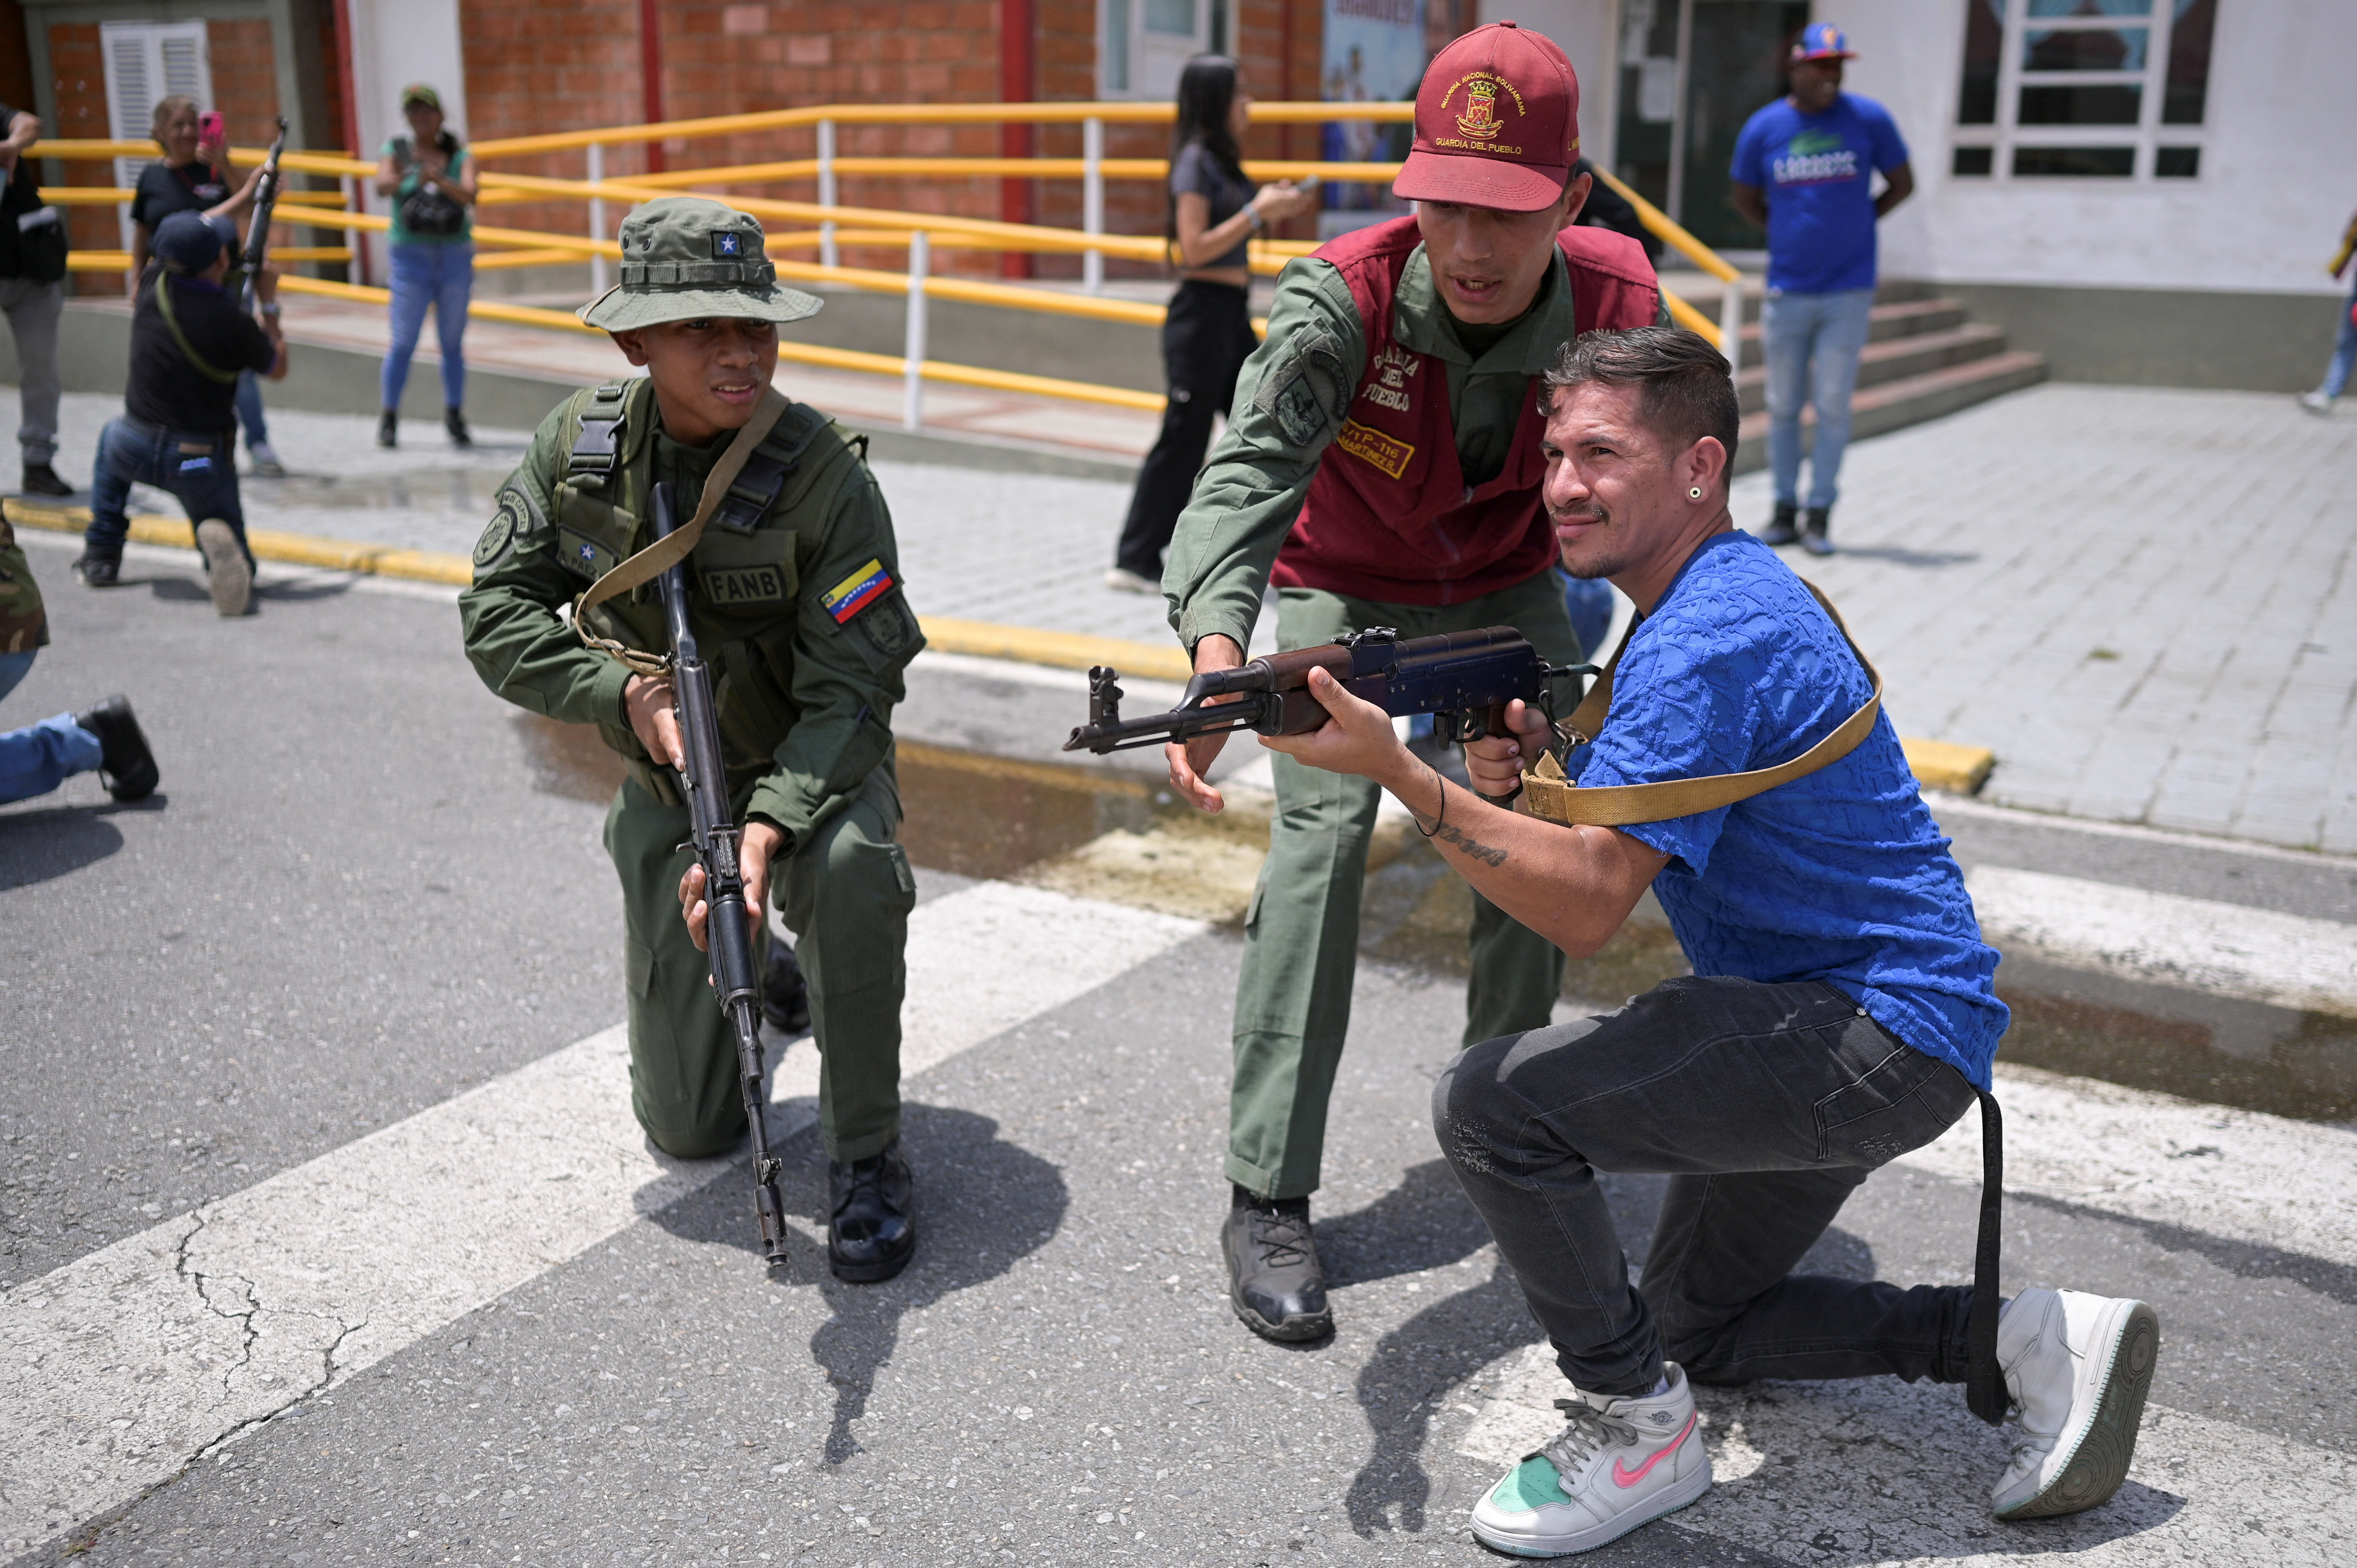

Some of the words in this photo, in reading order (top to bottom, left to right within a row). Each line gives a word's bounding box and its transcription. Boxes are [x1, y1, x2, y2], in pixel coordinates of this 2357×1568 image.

[1441, 81, 1461, 109] GUARDIA
[1461, 71, 1494, 84] NACIONAL
[1495, 76, 1526, 117] BOLIVARIANA
[1436, 137, 1469, 149] GUARDIA
[1470, 141, 1487, 151] DEL
[1380, 365, 1404, 388] DEL
[1342, 435, 1388, 466] MARTINEZ
[1361, 433, 1399, 459] P-116
[711, 571, 778, 601] FANB
